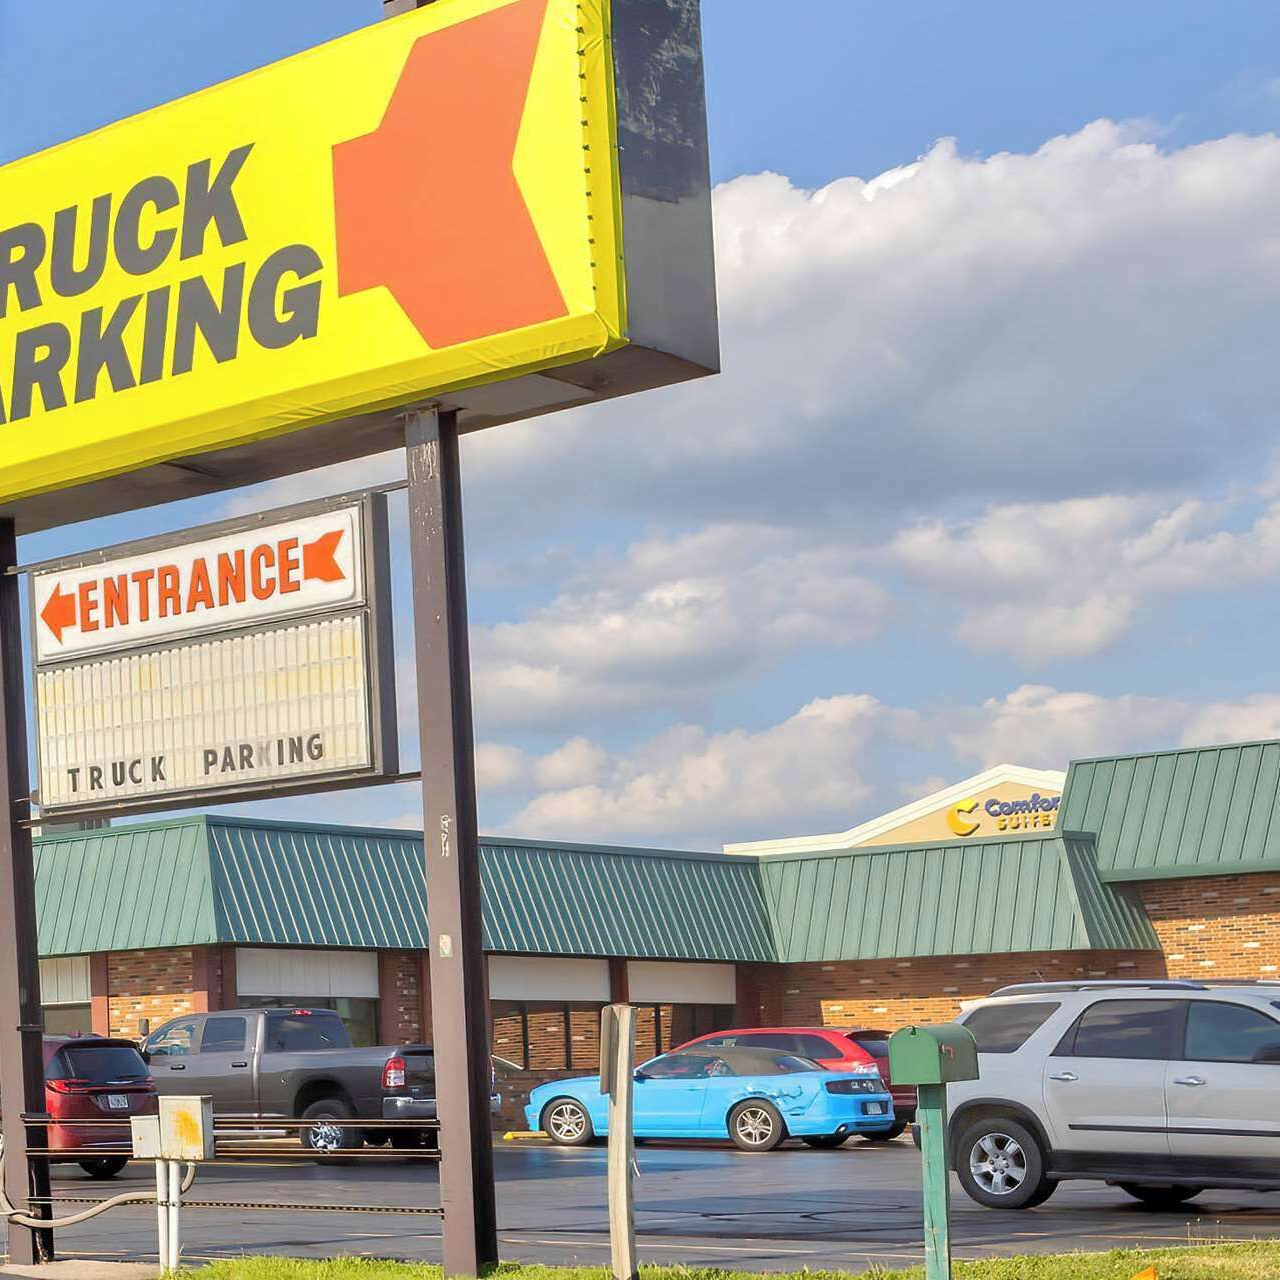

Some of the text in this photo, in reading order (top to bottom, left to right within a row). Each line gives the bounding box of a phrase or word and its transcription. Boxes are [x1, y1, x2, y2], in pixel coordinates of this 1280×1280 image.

[77, 537, 301, 633] ENTRANCE
[67, 755, 166, 793] TRUCK
[984, 793, 1060, 817] Comfor
[997, 813, 1058, 831] SUITE
